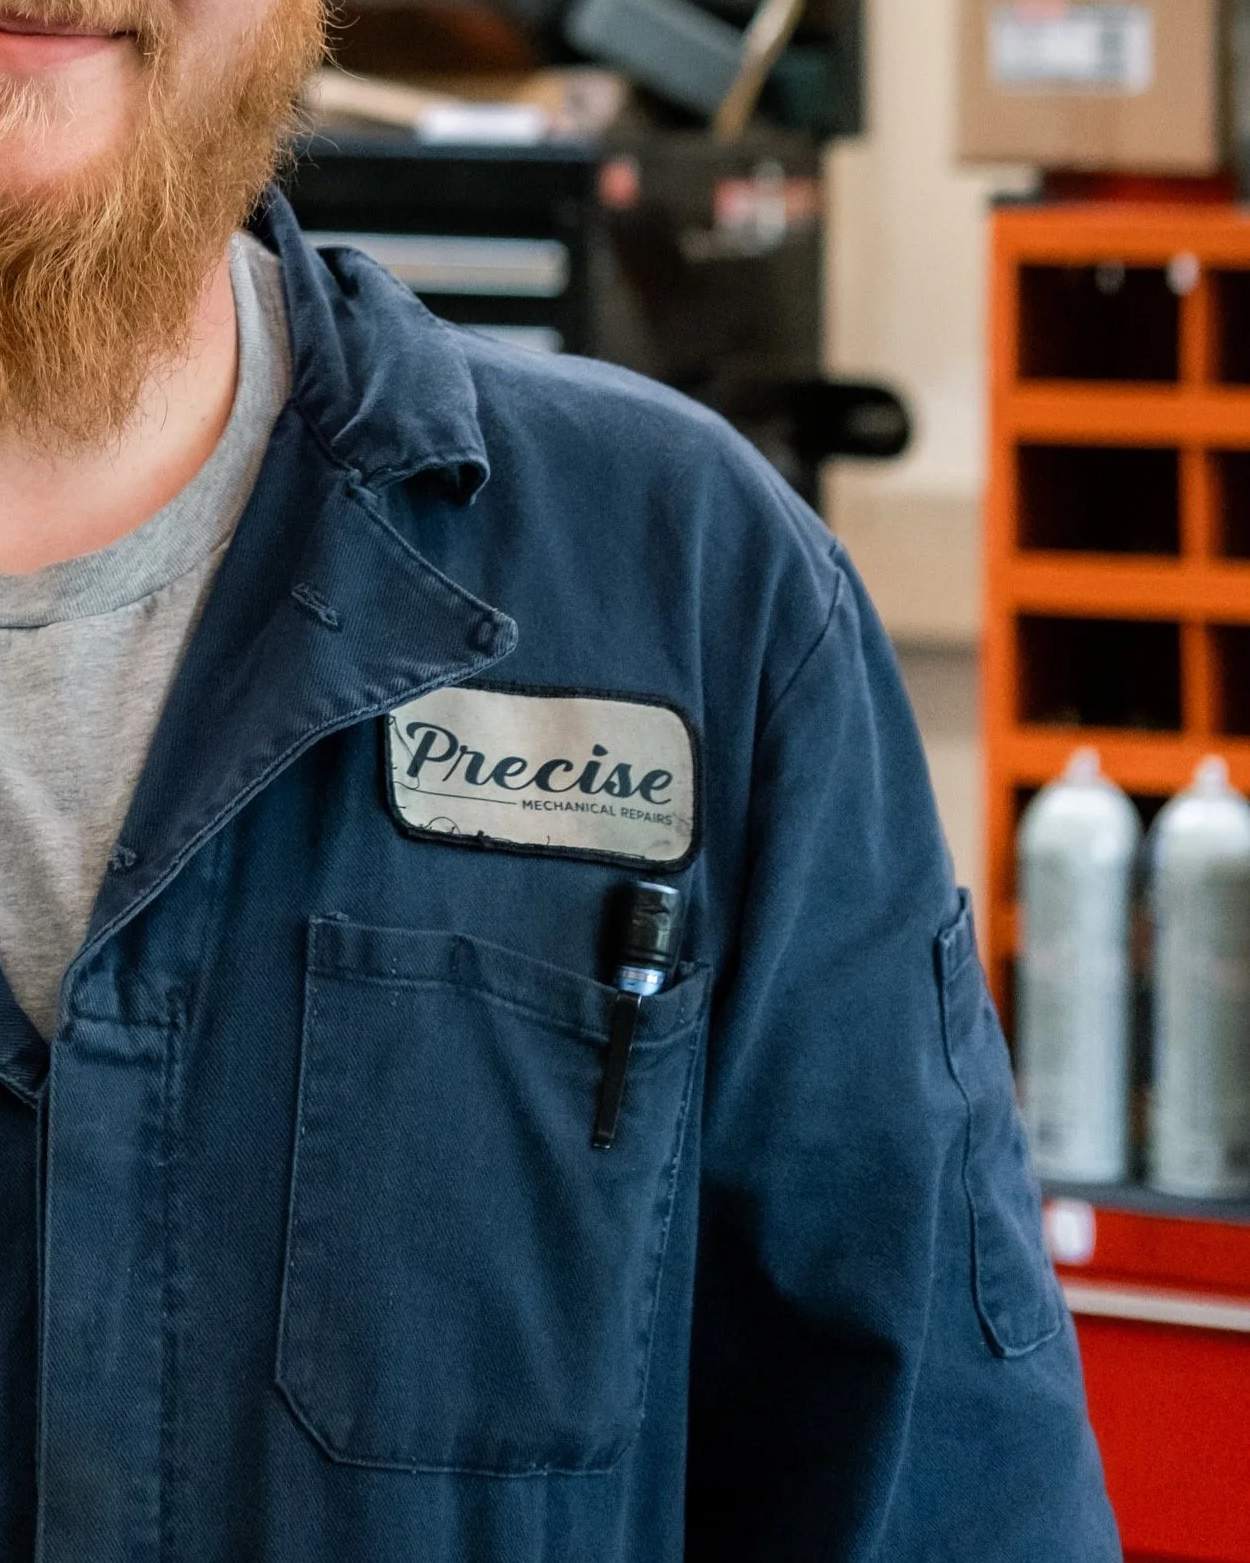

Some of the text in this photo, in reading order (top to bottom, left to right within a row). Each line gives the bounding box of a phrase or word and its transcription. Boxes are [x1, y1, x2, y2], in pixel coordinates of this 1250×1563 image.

[406, 722, 673, 805] Precise
[522, 799, 673, 826] MECHANICAL REPAIRS
